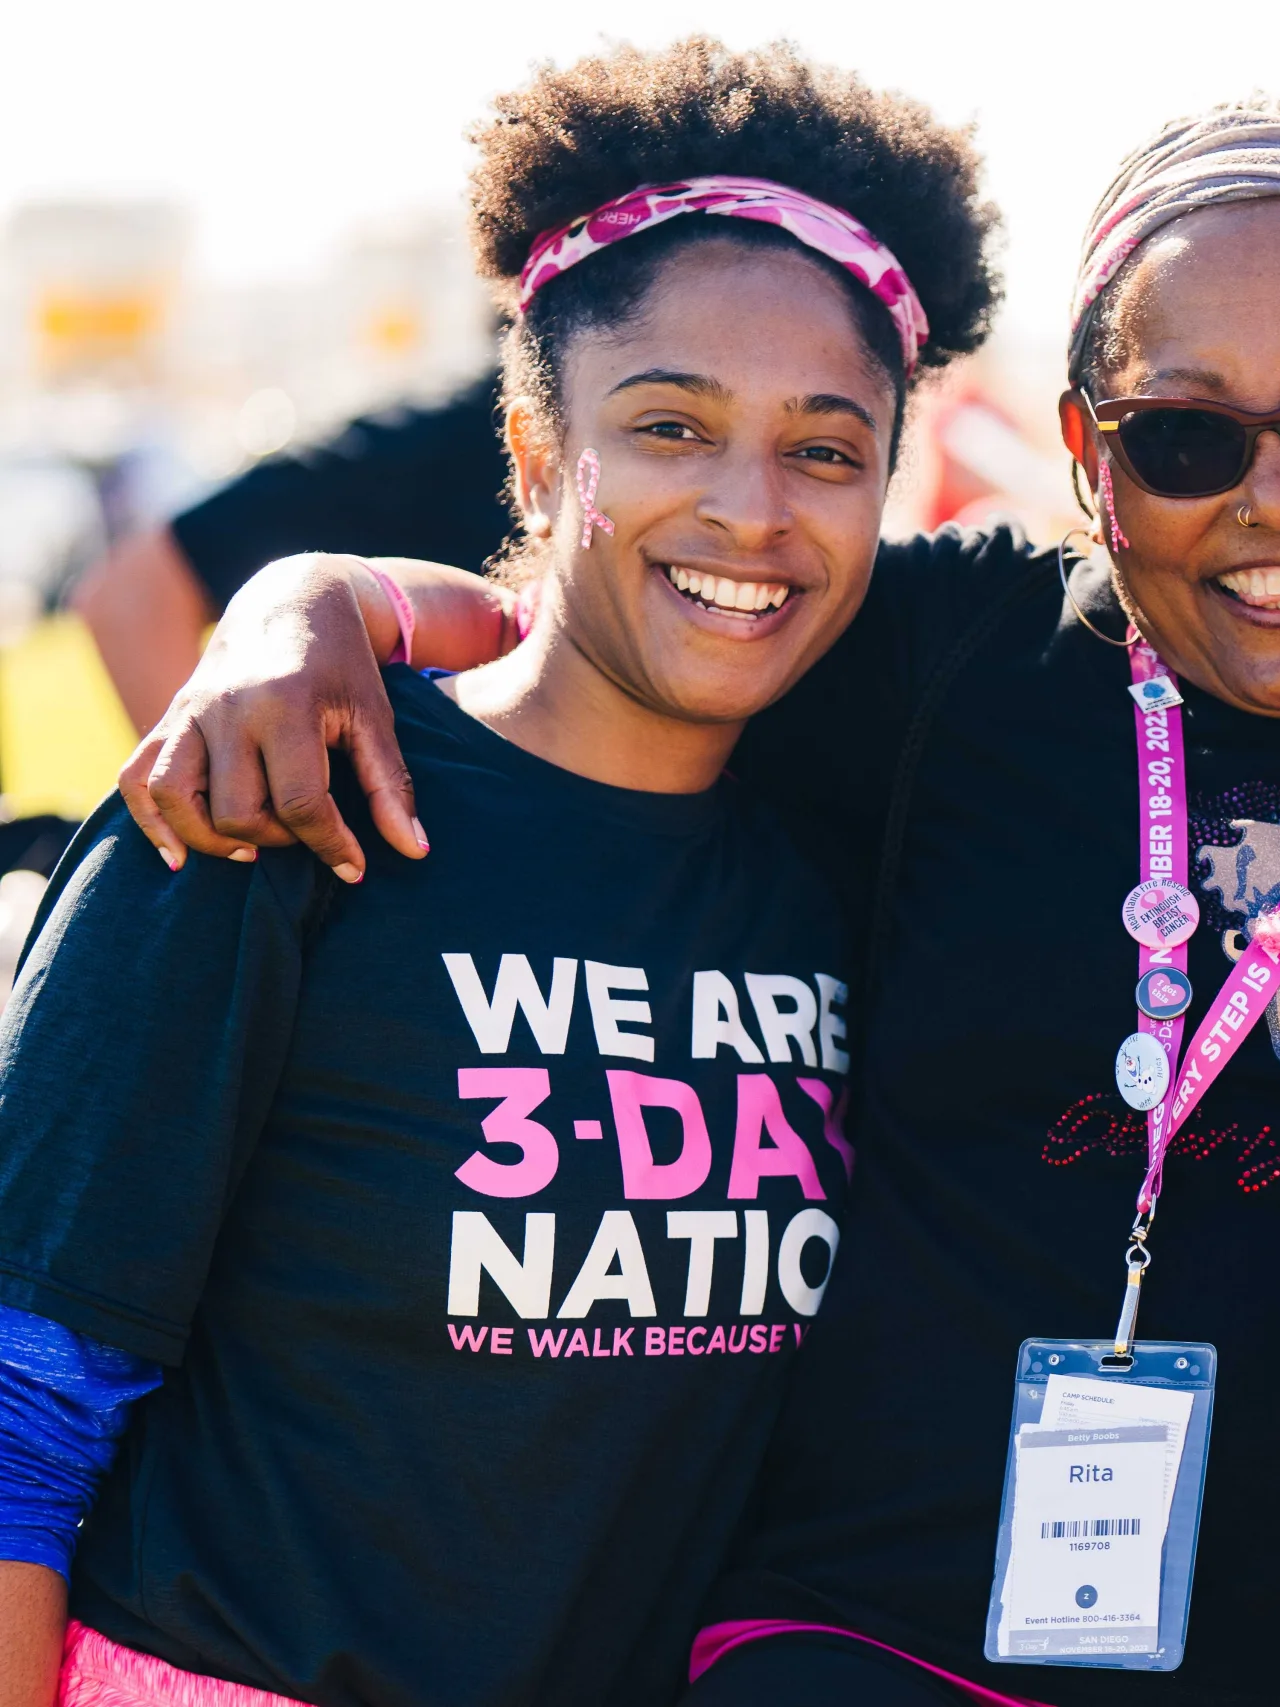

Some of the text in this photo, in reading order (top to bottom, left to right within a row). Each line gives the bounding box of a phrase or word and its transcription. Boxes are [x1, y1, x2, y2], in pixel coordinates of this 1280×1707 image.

[1147, 757, 1175, 819] 18-20,
[1125, 879, 1191, 932] Heartland Fire Rescue
[1140, 893, 1182, 924] EXTINGUISH
[1152, 905, 1182, 929] BREAST
[1160, 914, 1190, 937] CANCER
[1151, 988, 1170, 1005] this
[441, 953, 850, 1075] WE ARE
[1201, 991, 1250, 1062] STEP
[1249, 962, 1272, 993] IS
[453, 1067, 856, 1200] 3-DAY
[447, 1323, 514, 1355] WE
[527, 1327, 635, 1358] WALK
[645, 1323, 788, 1356] BECAUSE
[1062, 1391, 1081, 1400] CAMP
[1067, 1431, 1120, 1442] Betty Boobs
[1069, 1463, 1114, 1483] Rita
[1069, 1541, 1111, 1551] 1169708
[1025, 1613, 1141, 1625] Event Hotline 800-416-3364
[1060, 1645, 1103, 1654] NOVEMBER
[1079, 1635, 1129, 1645] SAN DIEGO
